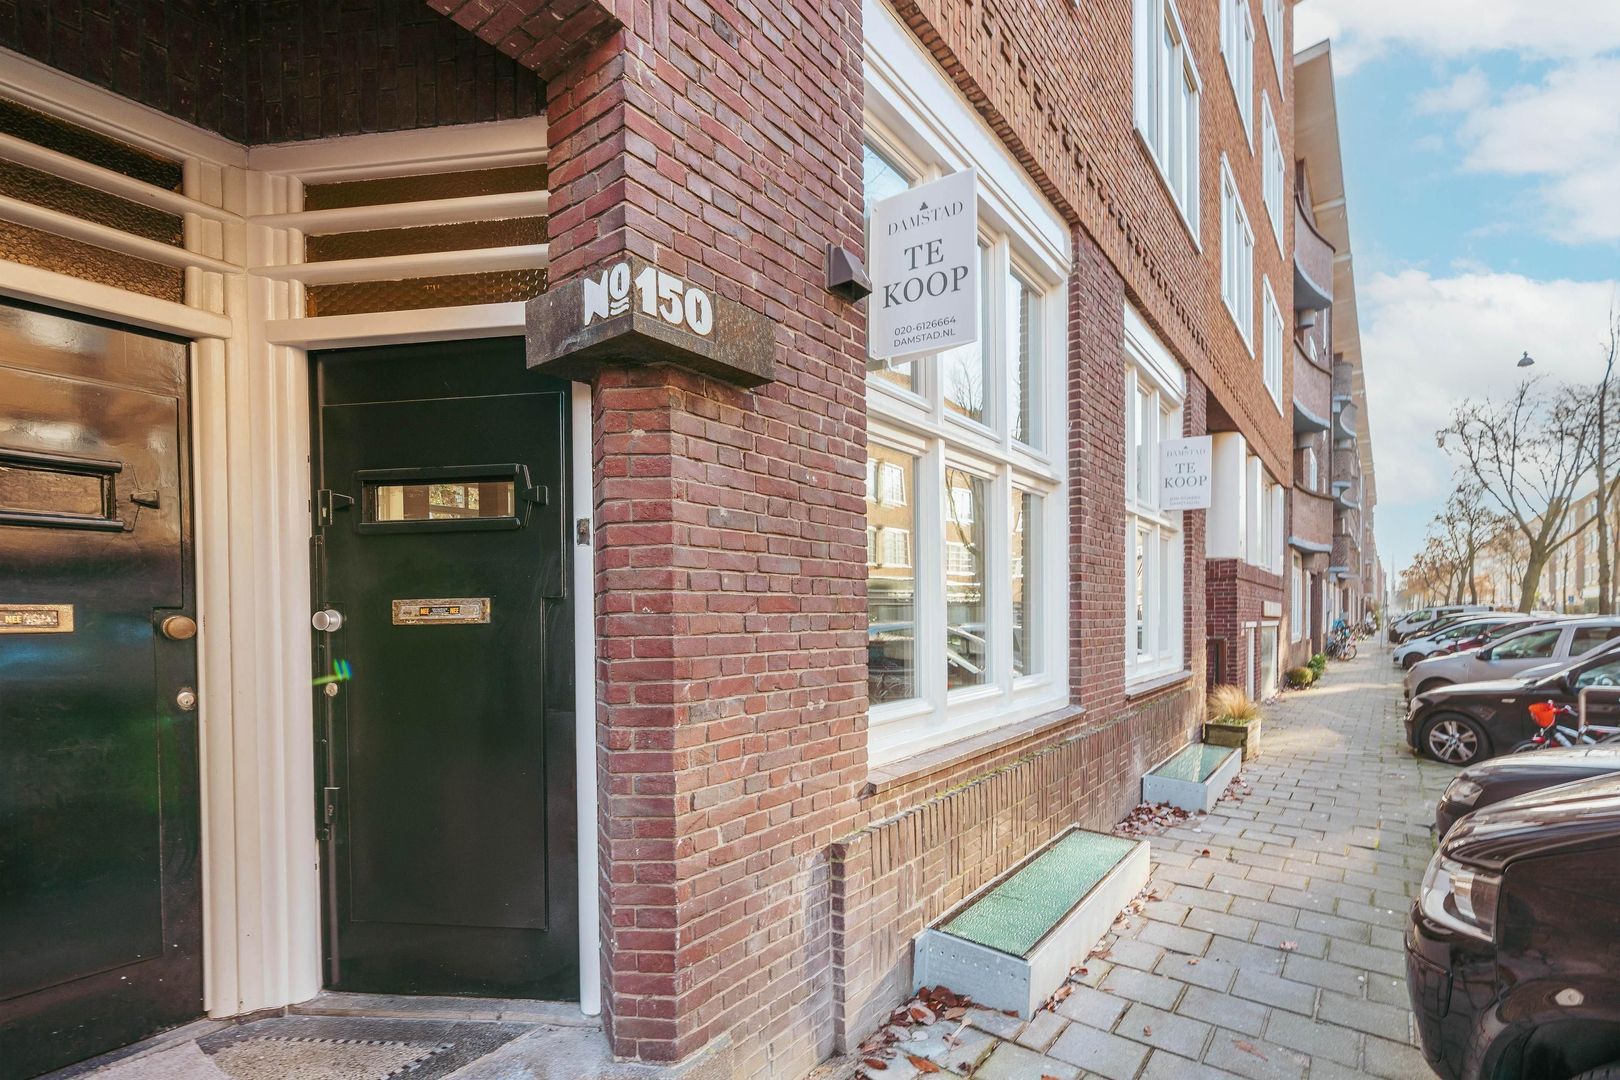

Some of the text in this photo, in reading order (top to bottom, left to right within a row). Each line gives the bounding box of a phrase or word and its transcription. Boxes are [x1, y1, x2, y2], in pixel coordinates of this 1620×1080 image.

[888, 201, 963, 236] DAMSTAD
[904, 238, 944, 271] TE
[883, 265, 969, 309] KOOP
[635, 266, 713, 336] 150
[894, 315, 956, 336] 020-6126664
[894, 328, 956, 348] DAMSTAD.NL
[1175, 462, 1196, 474] TE
[1164, 475, 1208, 488] KOOP
[5, 615, 23, 624] NEE
